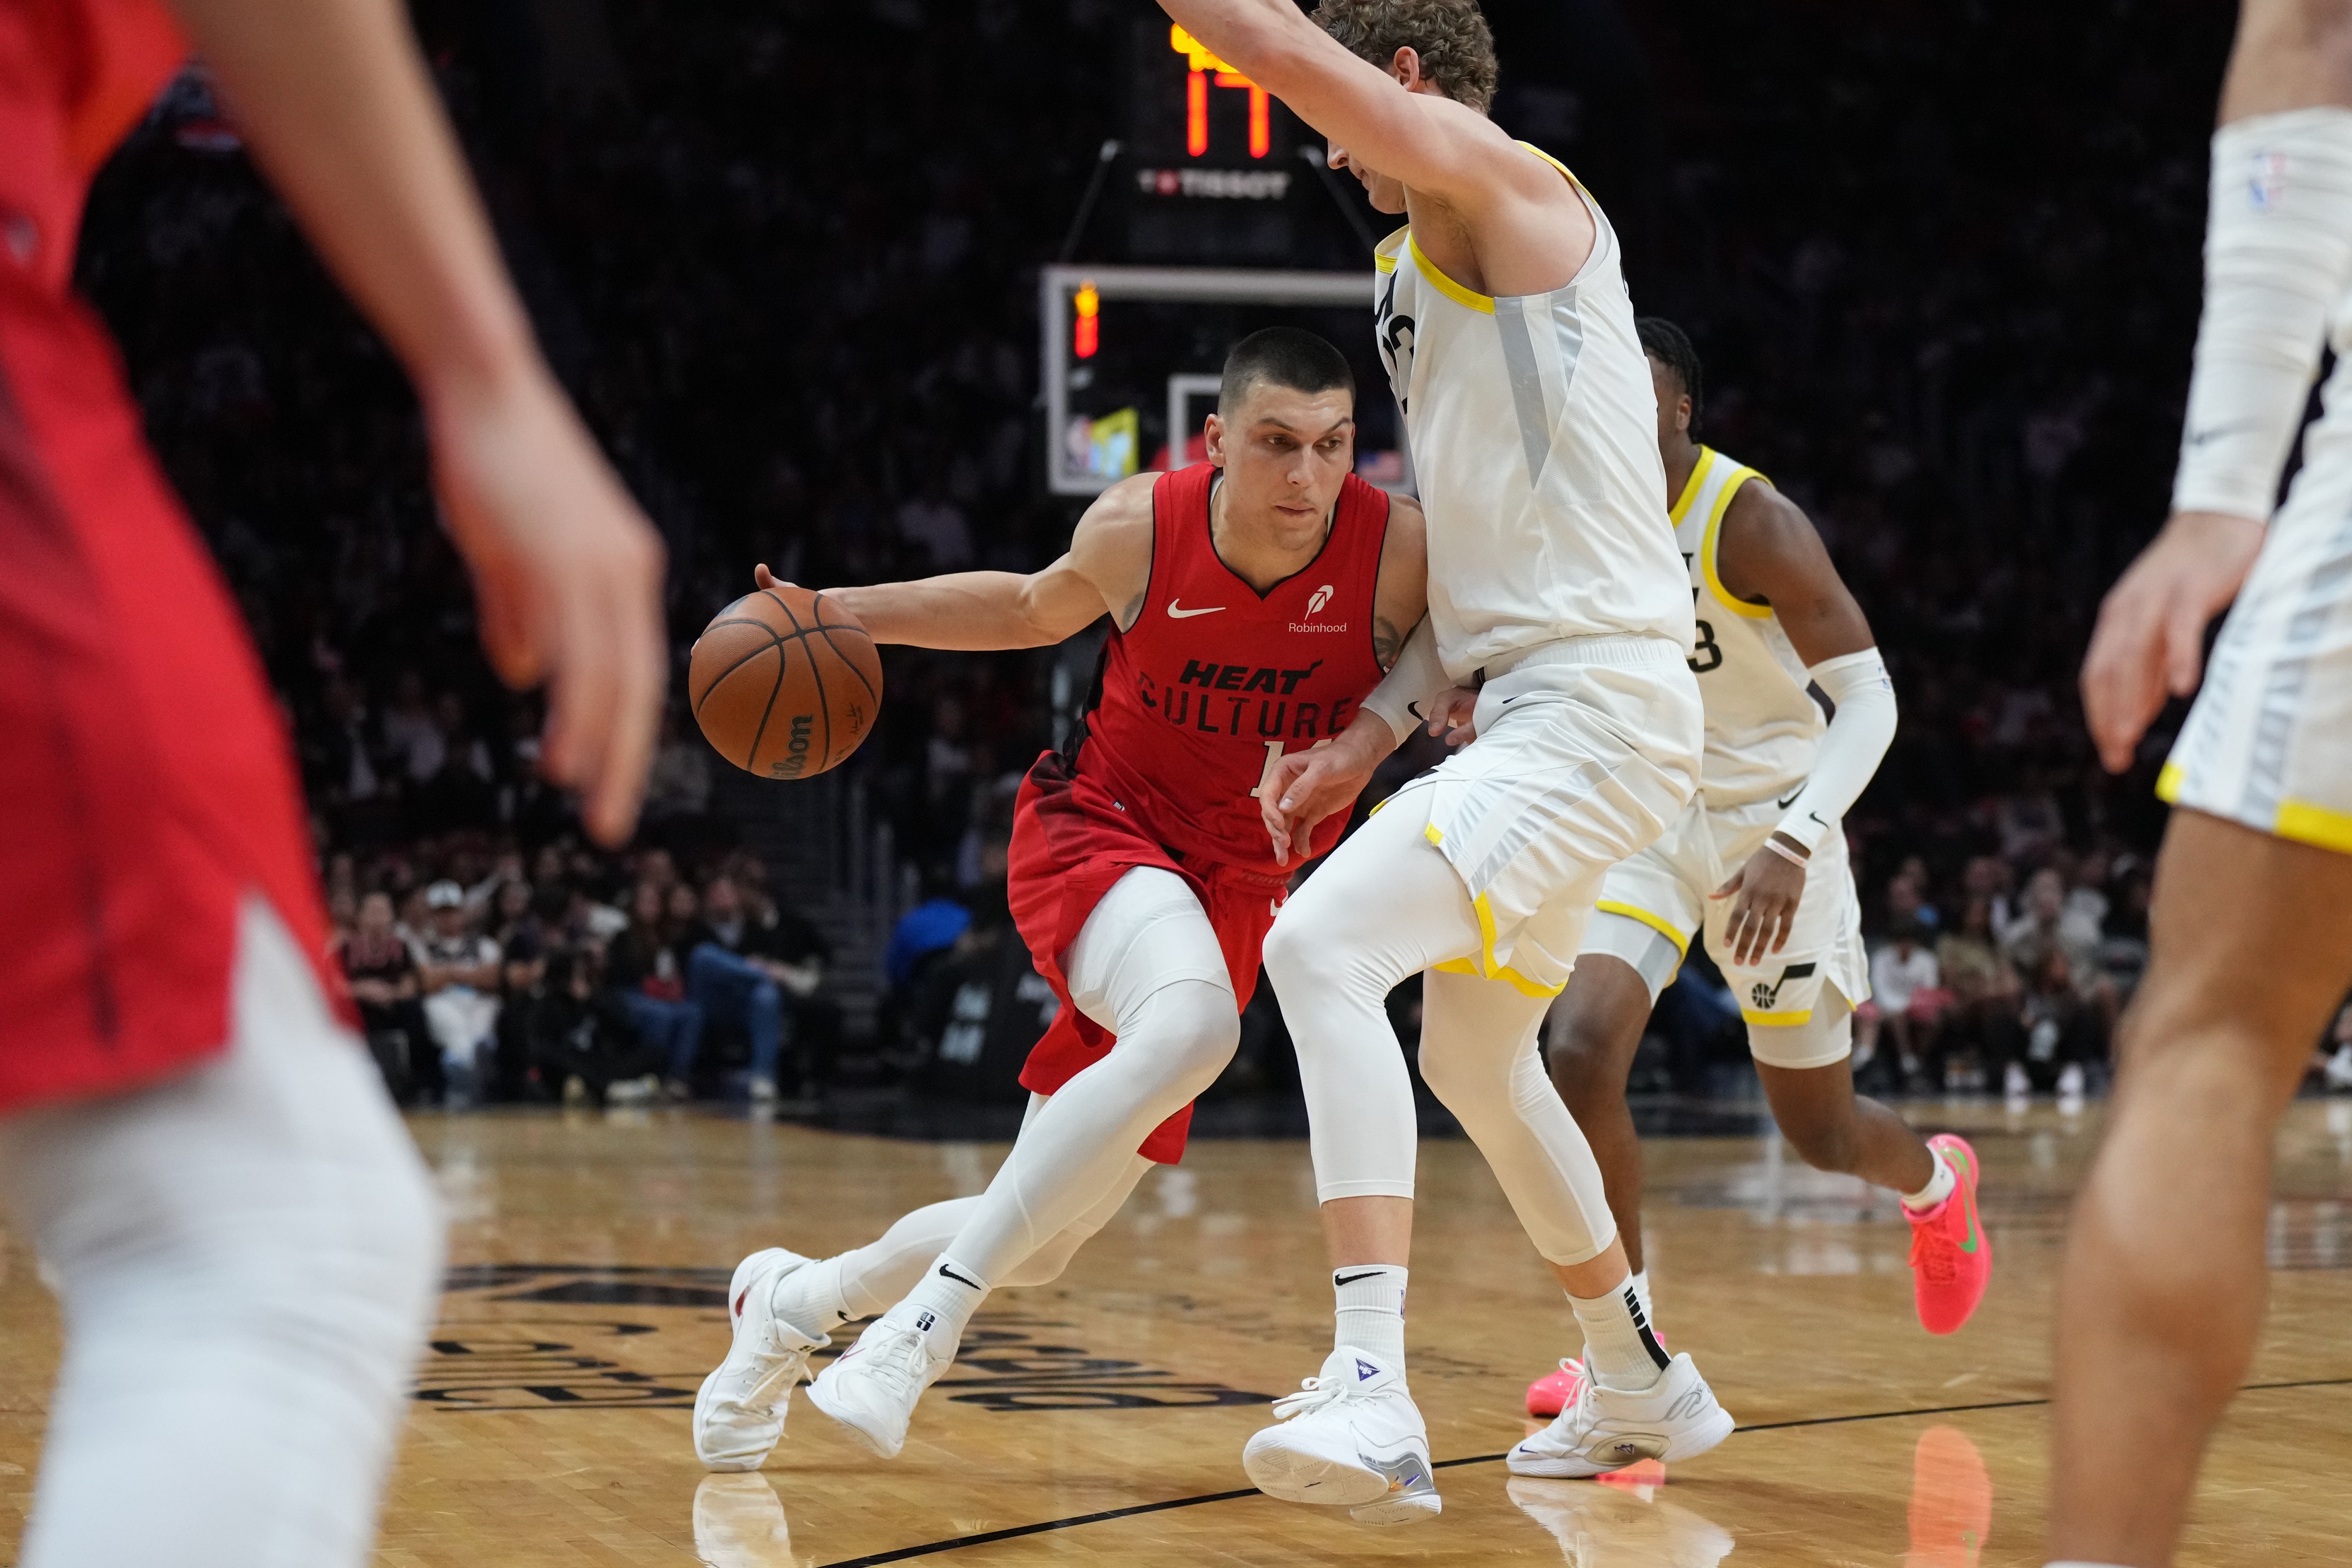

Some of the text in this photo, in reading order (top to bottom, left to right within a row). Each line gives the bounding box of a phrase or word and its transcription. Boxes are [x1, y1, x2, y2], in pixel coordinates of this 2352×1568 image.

[1187, 71, 1270, 158] 17
[1288, 622, 1347, 633] Robinhood
[1179, 659, 1324, 695] HEAT
